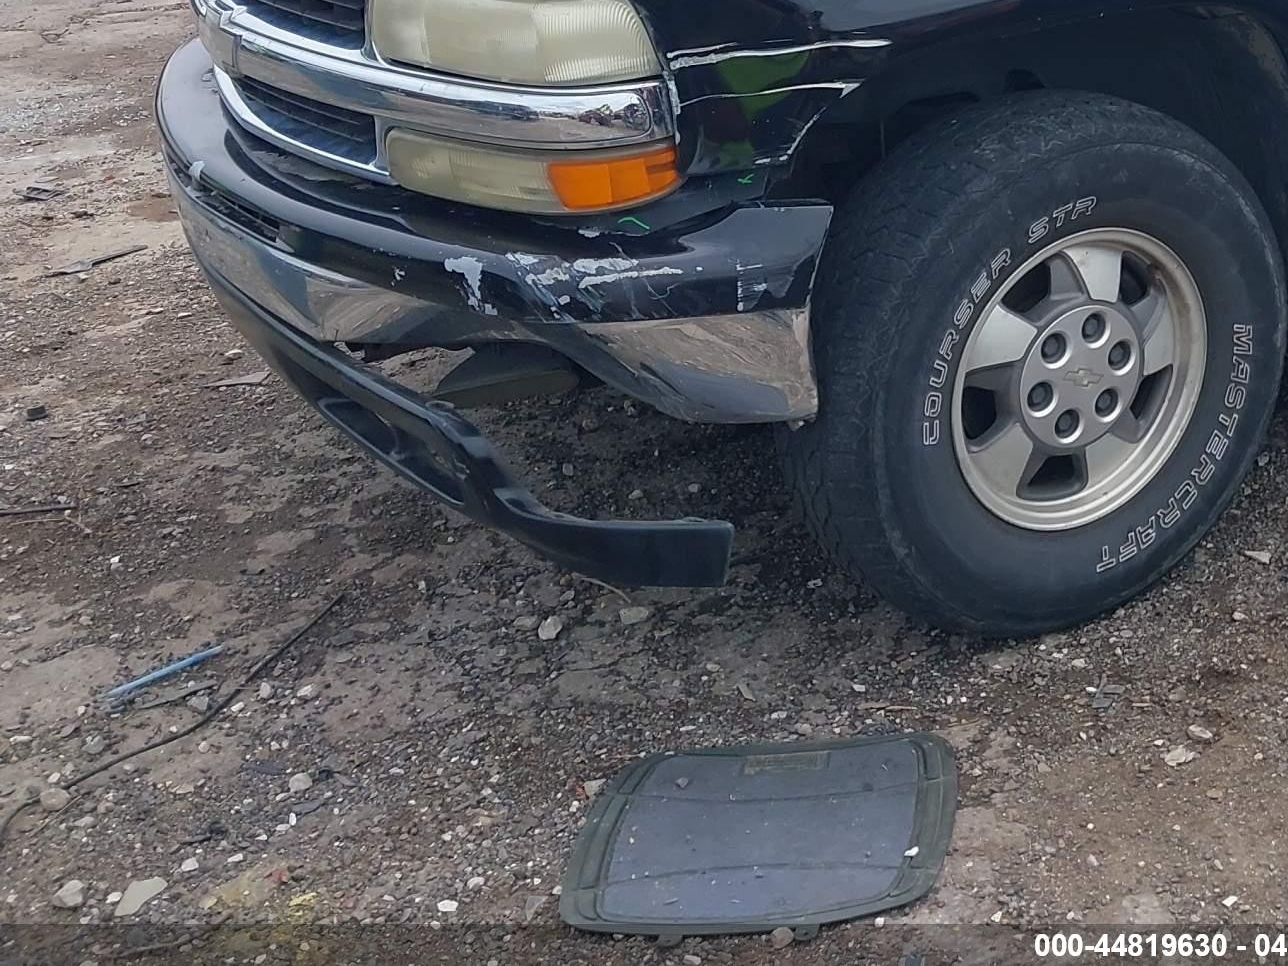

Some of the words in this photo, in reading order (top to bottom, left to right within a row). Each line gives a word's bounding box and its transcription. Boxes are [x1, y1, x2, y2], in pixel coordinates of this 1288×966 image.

[923, 248, 1012, 446] COURSER
[1028, 196, 1097, 244] STR
[1096, 323, 1253, 573] MASTERCRAFT
